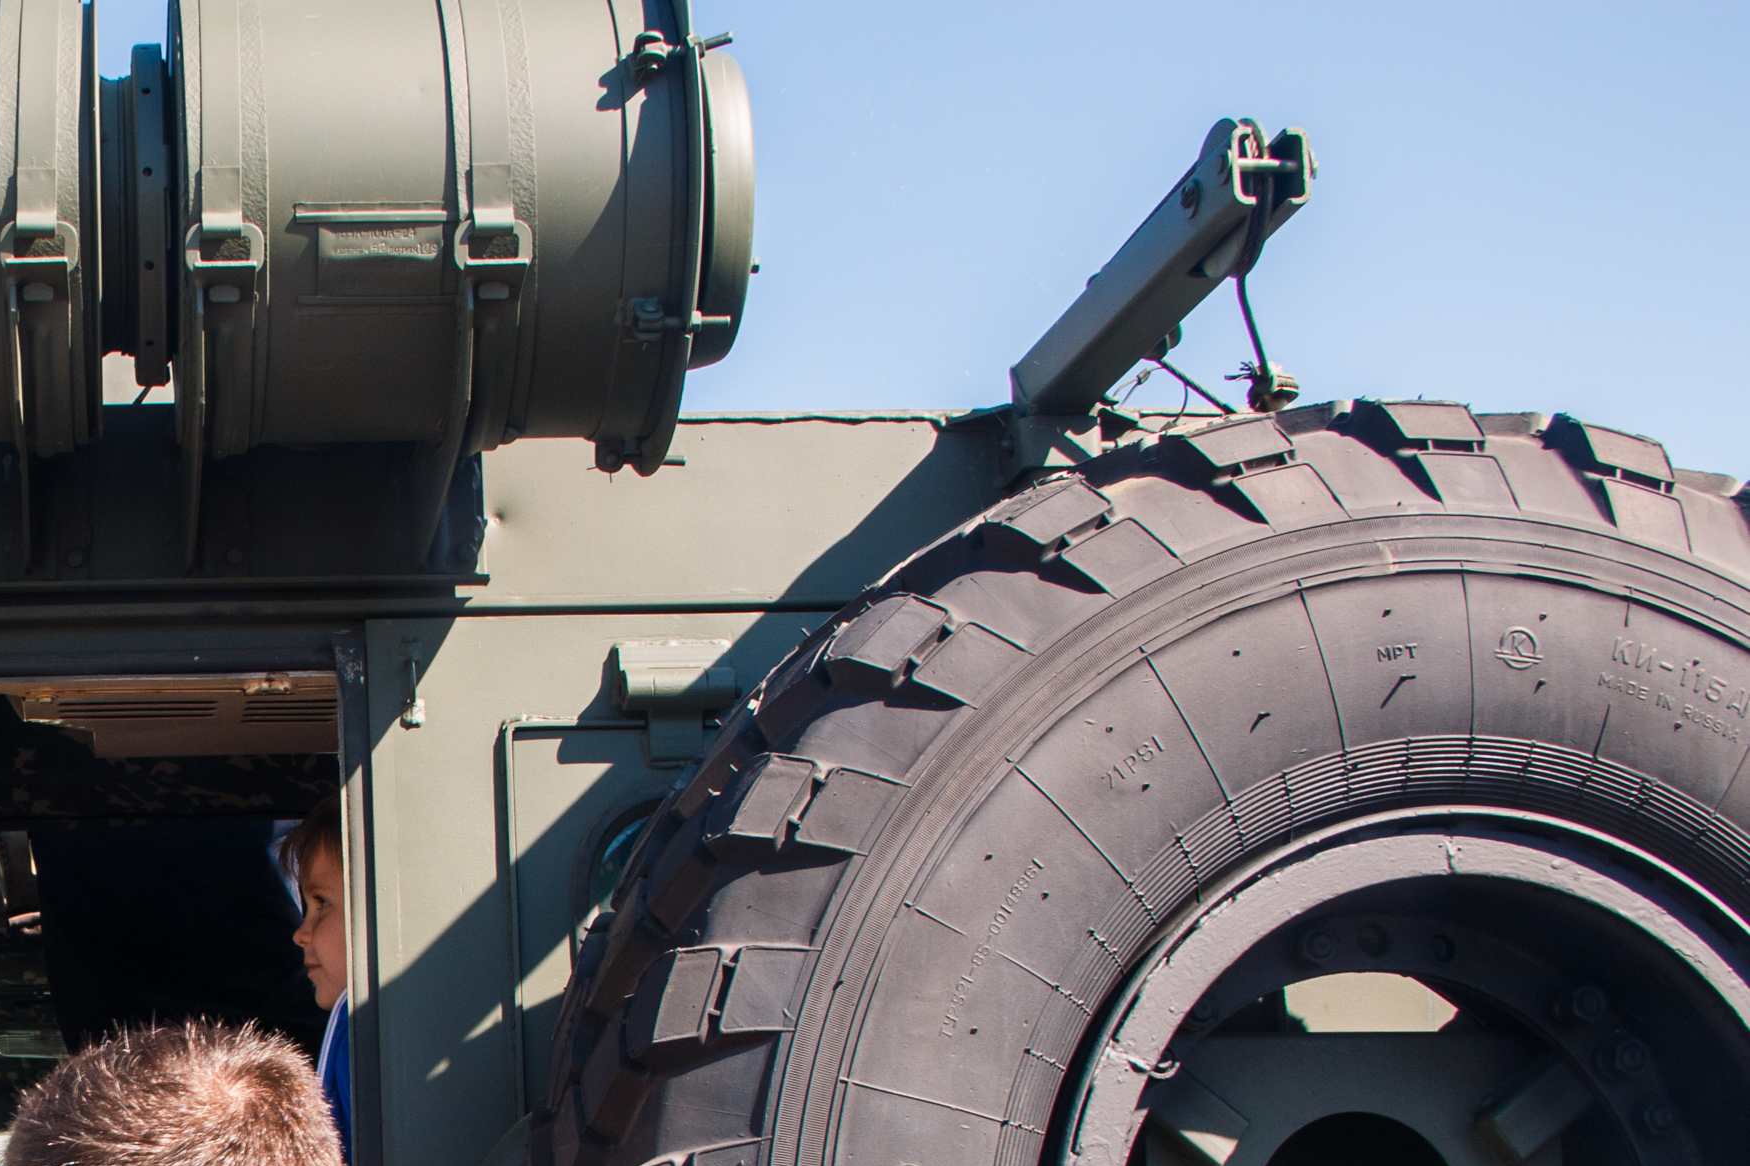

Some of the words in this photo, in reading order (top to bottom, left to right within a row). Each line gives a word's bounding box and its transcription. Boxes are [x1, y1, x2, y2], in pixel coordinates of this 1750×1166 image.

[1598, 672, 1650, 701] MADE
[1655, 692, 1676, 711] IN
[1680, 703, 1740, 743] RUSSIA
